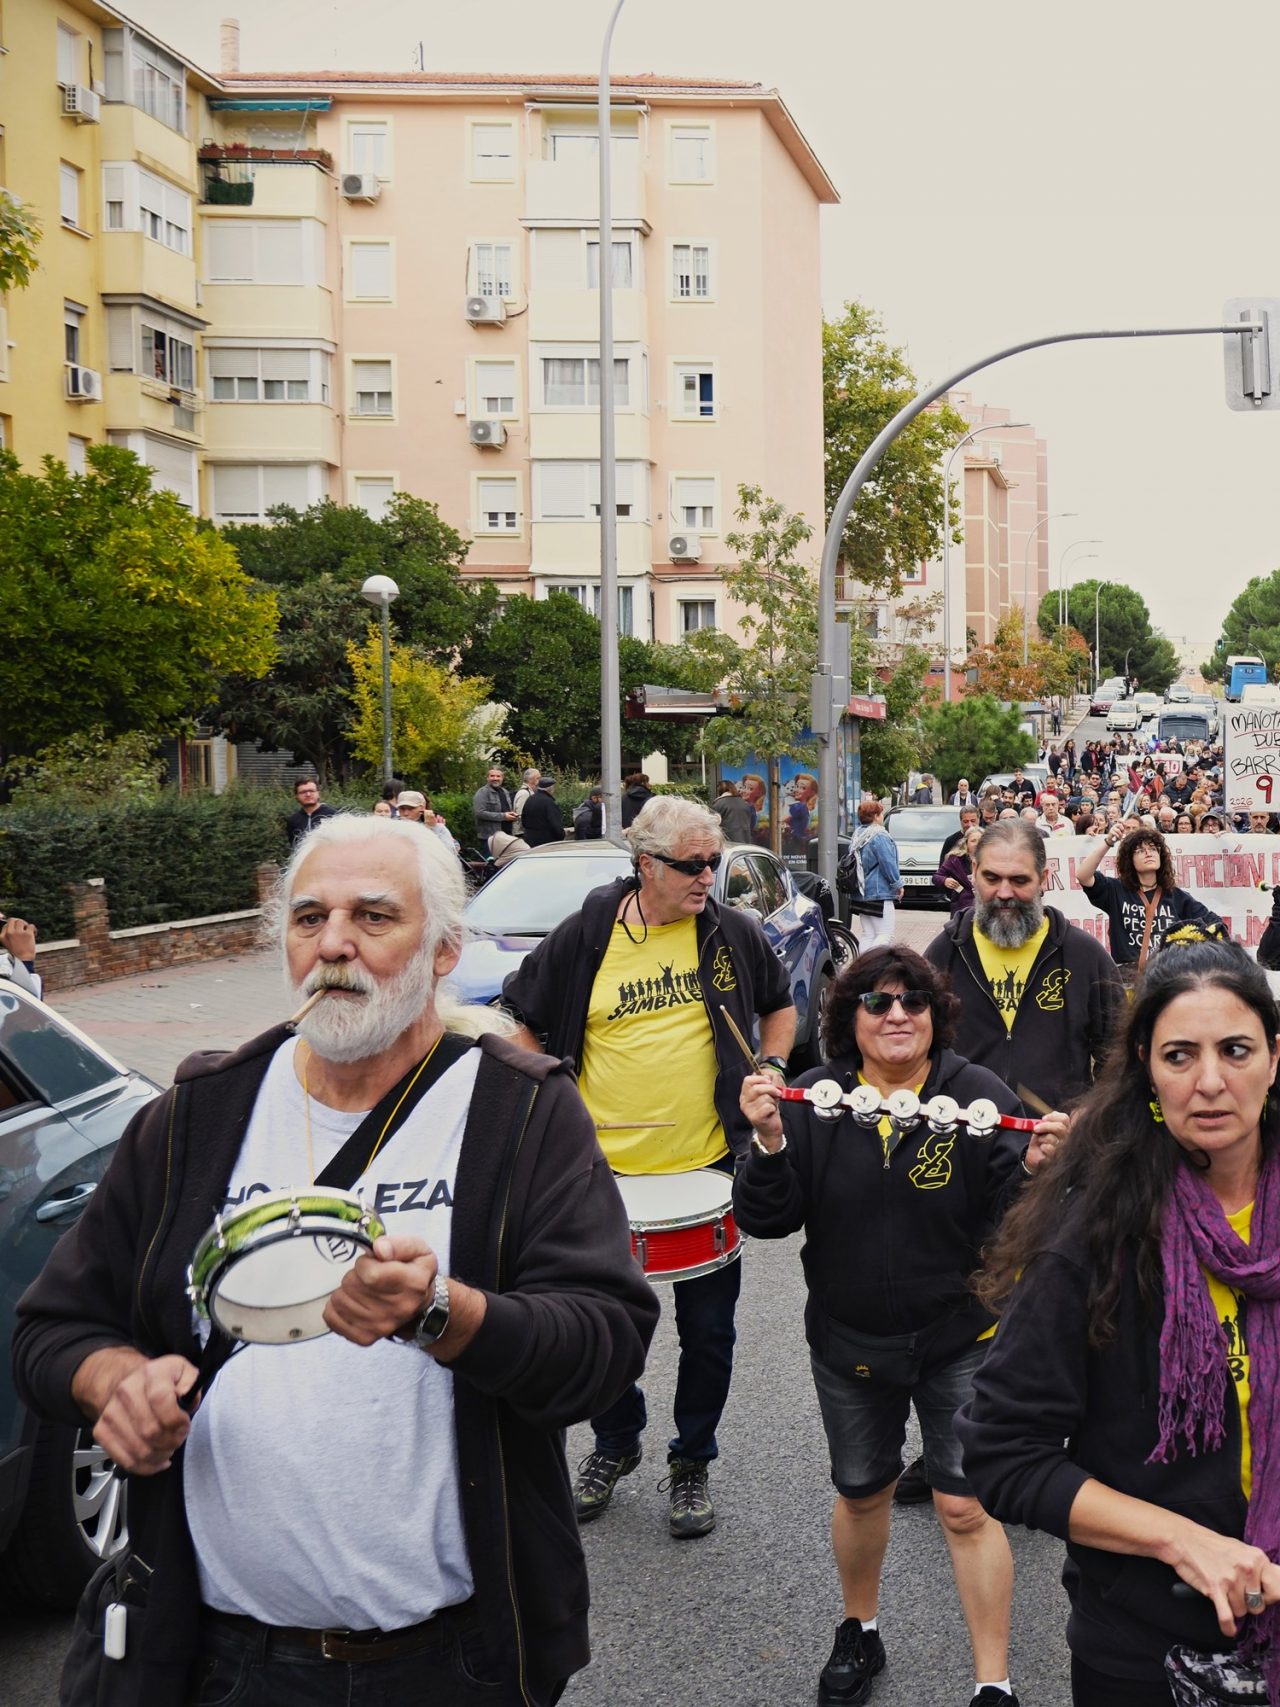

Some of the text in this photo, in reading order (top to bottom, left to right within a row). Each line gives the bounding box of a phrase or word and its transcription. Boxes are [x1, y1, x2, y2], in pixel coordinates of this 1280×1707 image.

[1256, 775, 1273, 804] 9
[1122, 901, 1175, 918] NORAL
[1128, 932, 1161, 948] SCR
[607, 988, 704, 1021] SAMBALE
